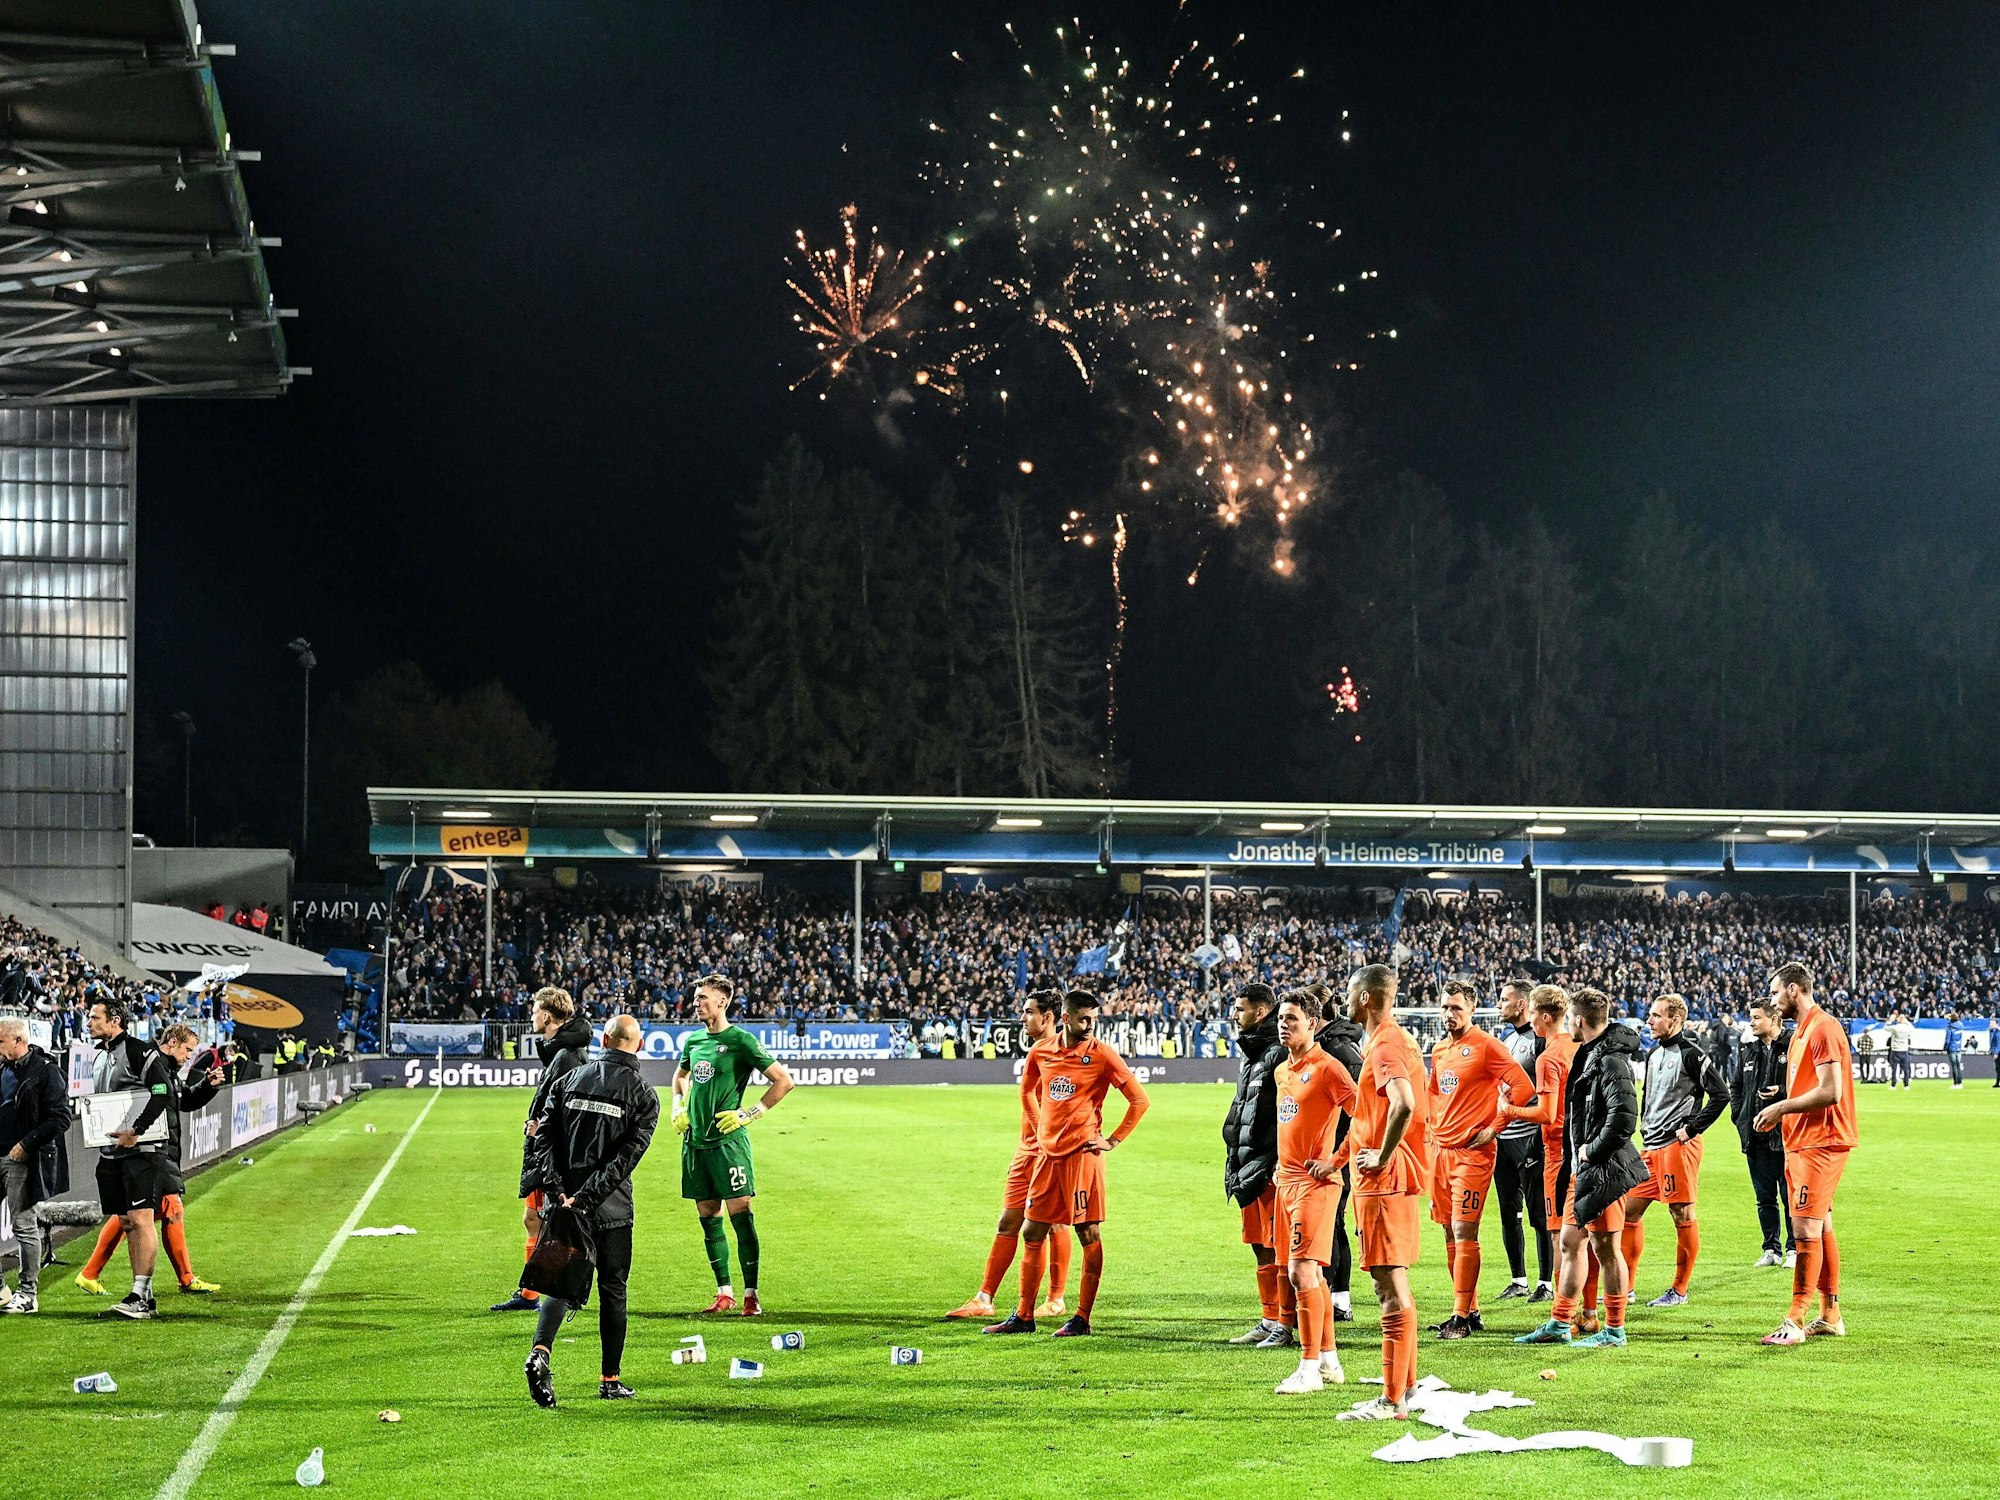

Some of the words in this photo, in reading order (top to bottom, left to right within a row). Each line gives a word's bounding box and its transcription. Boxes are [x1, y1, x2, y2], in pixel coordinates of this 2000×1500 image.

[448, 826, 523, 852] entega
[1228, 840, 1505, 863] Jonathan-Heimes-Tribüne
[760, 1029, 879, 1049] Lilien-Power
[861, 1068, 876, 1077] AG
[1151, 1066, 1166, 1075] AG
[729, 1166, 747, 1186] 25
[1664, 1174, 1676, 1193] 31
[1074, 1190, 1089, 1211] 10
[1461, 1190, 1480, 1210] 26
[1800, 1185, 1809, 1205] 6
